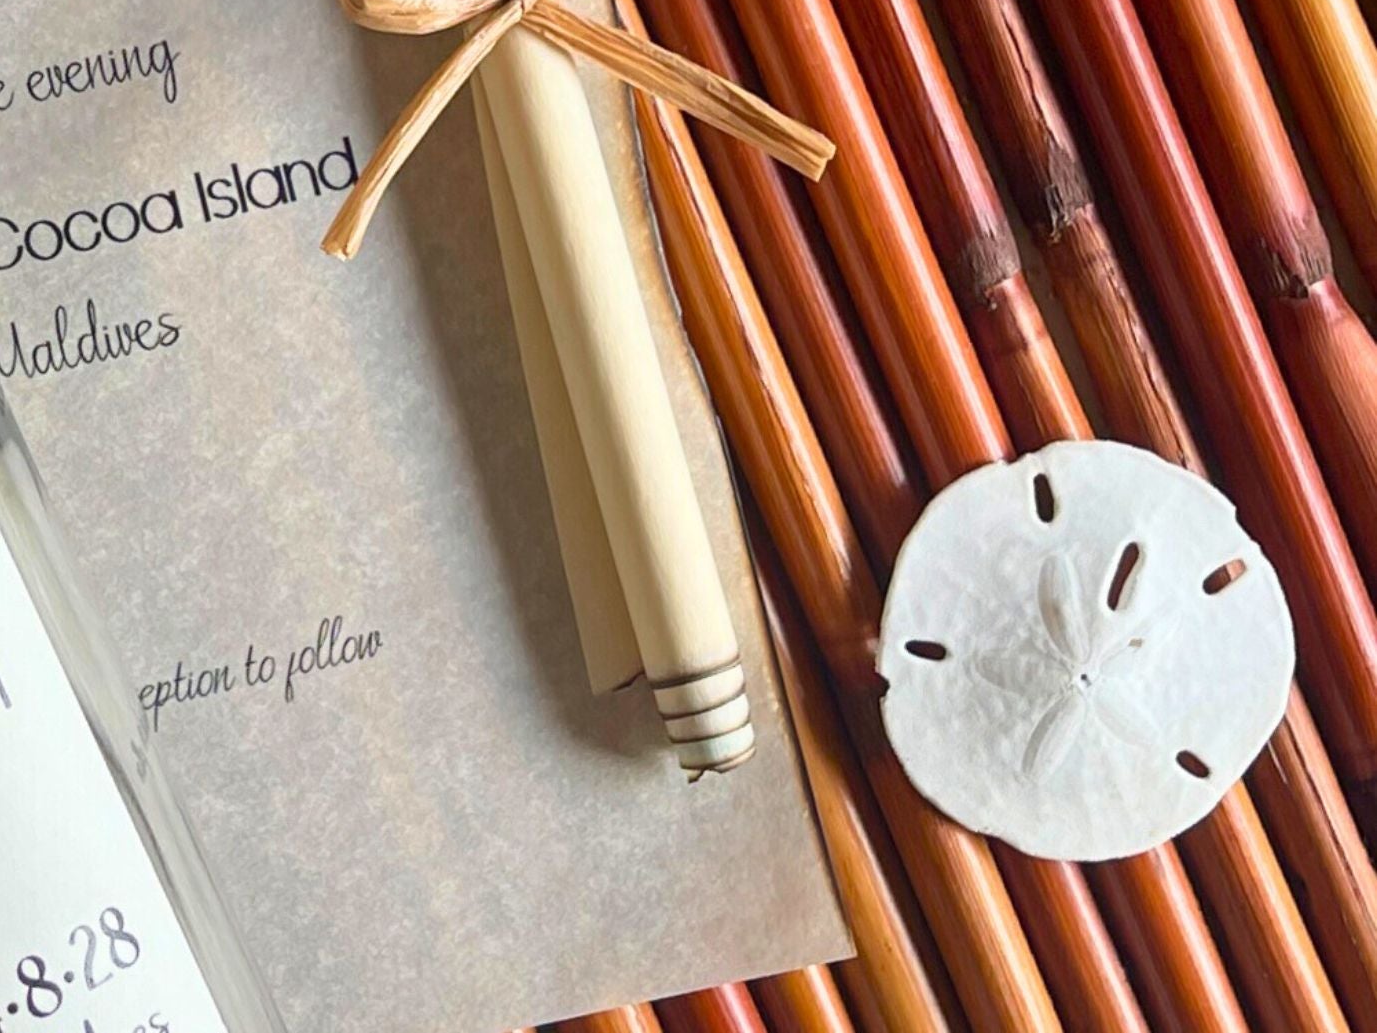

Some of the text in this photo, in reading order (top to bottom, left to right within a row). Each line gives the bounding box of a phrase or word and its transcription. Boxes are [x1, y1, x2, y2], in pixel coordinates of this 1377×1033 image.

[26, 39, 181, 104] evening
[195, 136, 359, 224] Island
[244, 644, 277, 688] to
[284, 614, 384, 703] follow
